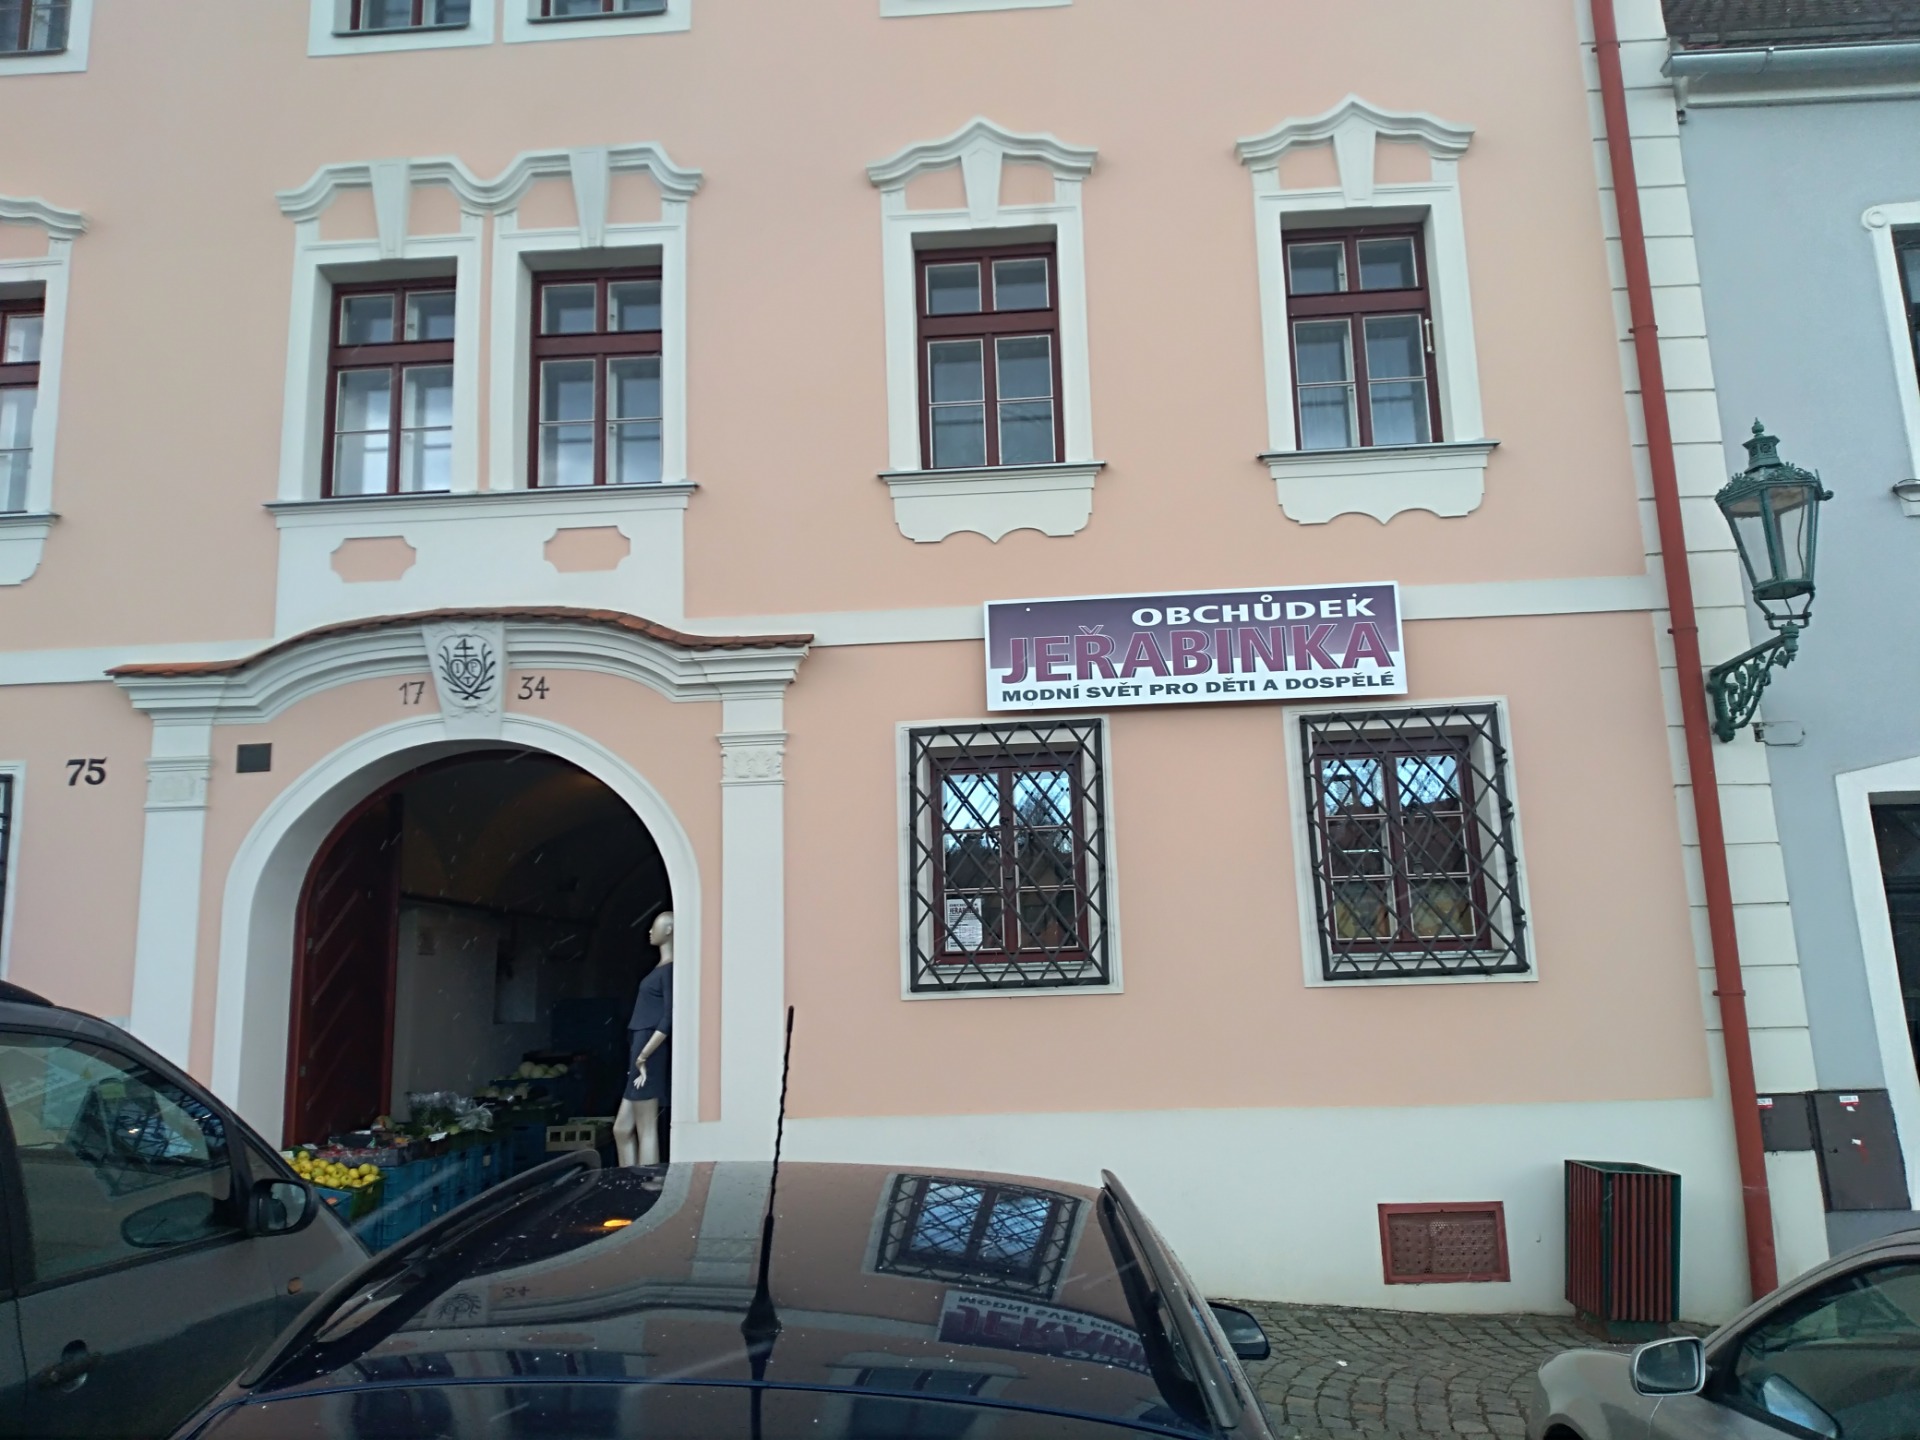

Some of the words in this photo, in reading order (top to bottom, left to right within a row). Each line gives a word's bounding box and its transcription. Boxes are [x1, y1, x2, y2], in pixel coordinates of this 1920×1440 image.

[1131, 594, 1376, 627] OBCHŮDEK
[1001, 622, 1396, 685] JEŘABINKA
[398, 681, 425, 705] 17
[517, 676, 550, 700] 34
[1002, 684, 1080, 702] MODNÍ
[1086, 682, 1143, 699] SVĚT
[1149, 683, 1199, 696] PRO
[1206, 677, 1256, 693] DĚTI
[1263, 679, 1279, 691] A
[1285, 671, 1395, 690] DOSPĚLÉ
[65, 757, 107, 786] 75
